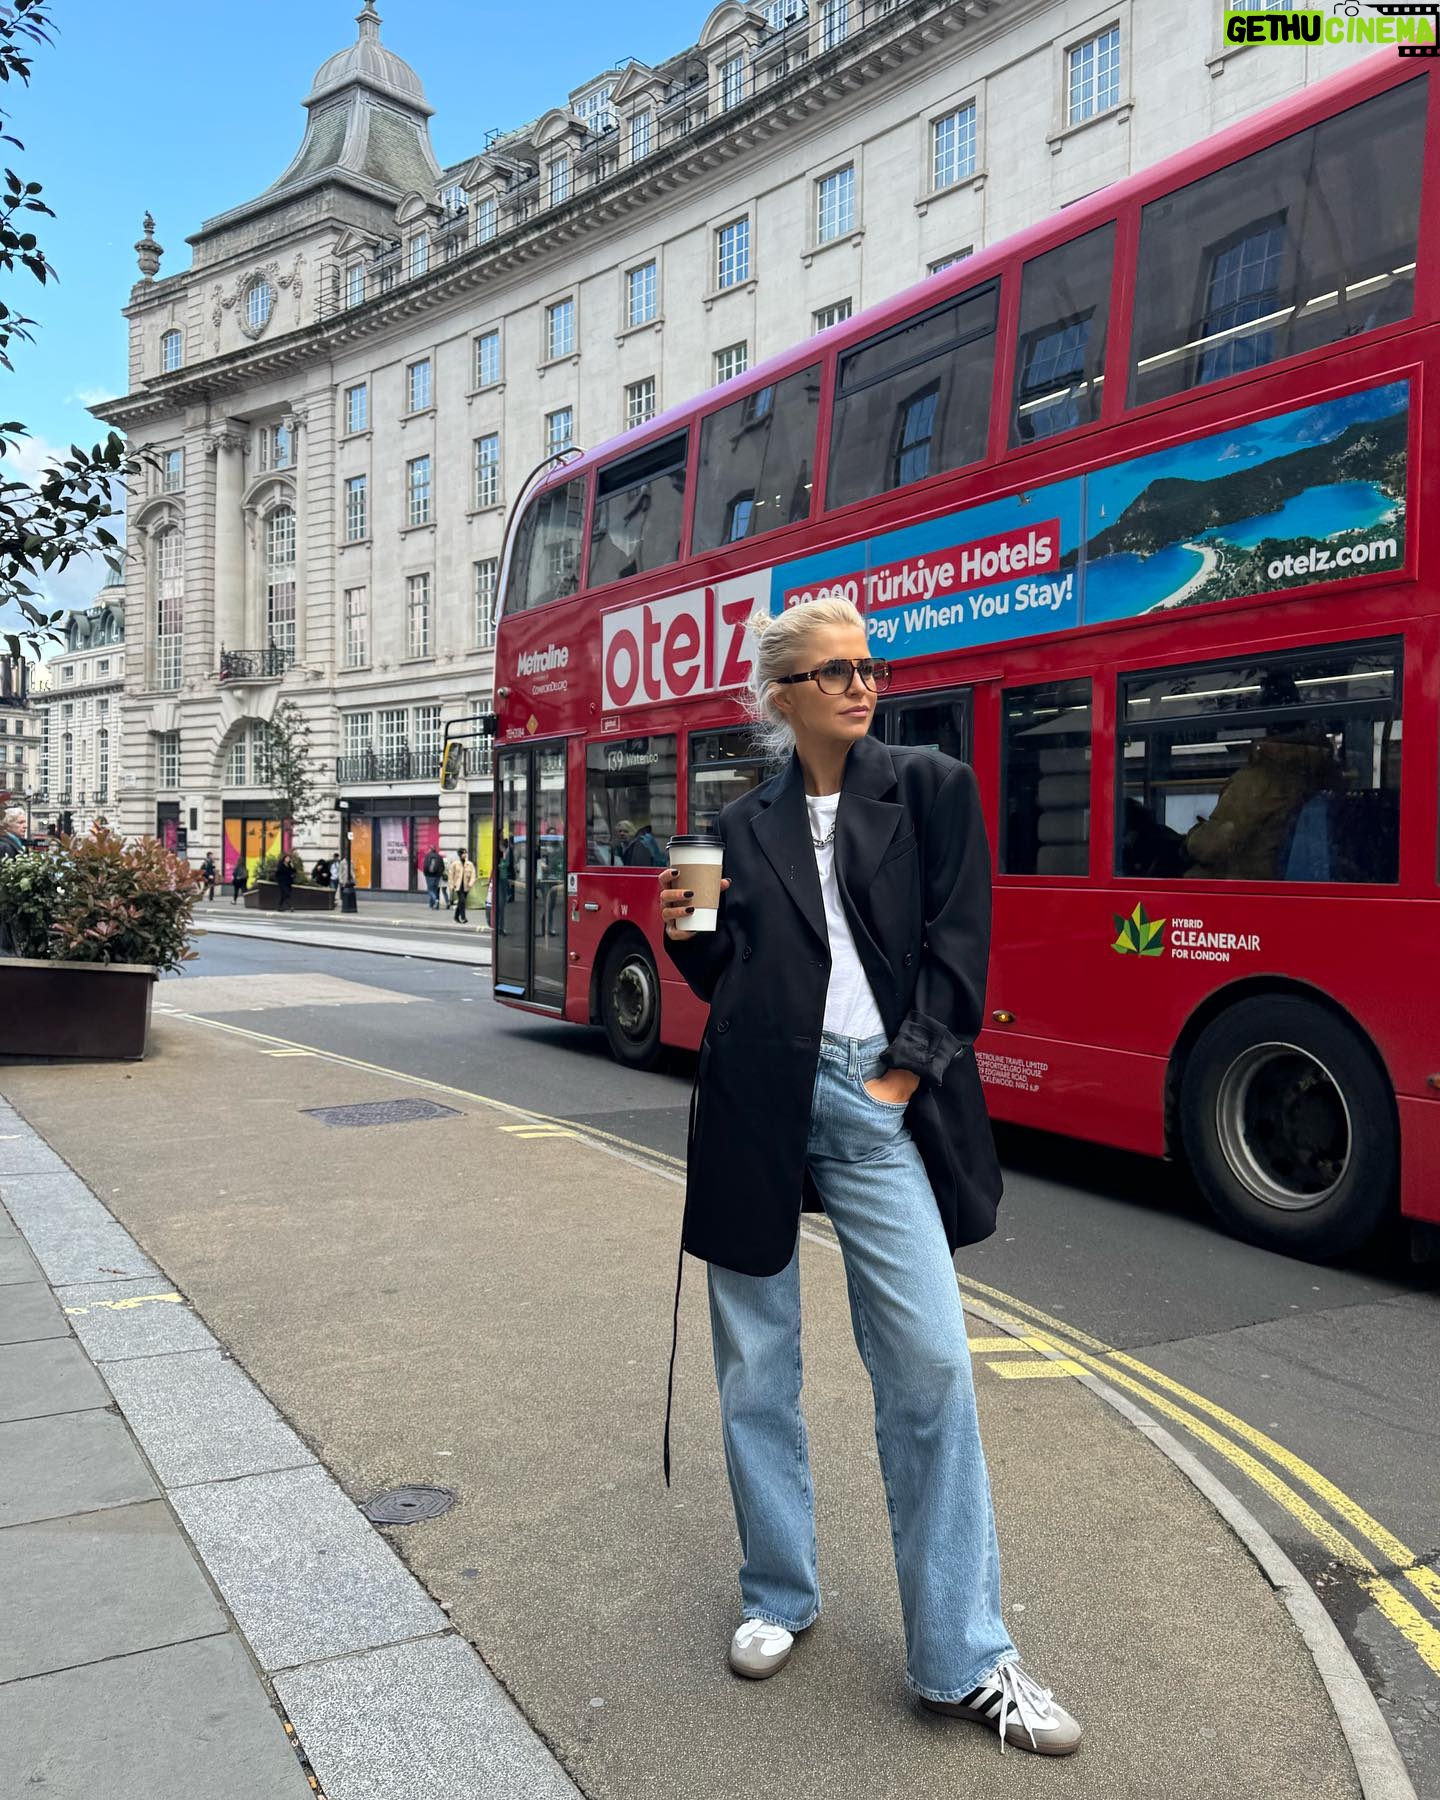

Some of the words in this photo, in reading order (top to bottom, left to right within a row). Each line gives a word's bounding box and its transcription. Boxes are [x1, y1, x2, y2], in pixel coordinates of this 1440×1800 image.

[863, 559, 955, 605] Türkiye
[961, 531, 1052, 583] Hotels
[1267, 538, 1397, 579] otelz.com
[867, 617, 900, 643] Pay
[904, 601, 963, 633] When
[968, 593, 1009, 620] You
[1015, 573, 1073, 611] Stay!
[516, 644, 569, 677] Metroline
[606, 587, 755, 707] otelz
[608, 750, 623, 772] 139
[626, 753, 659, 766] Waterloo
[1172, 918, 1203, 928] HYBRID
[1172, 949, 1189, 959] FOR
[1190, 950, 1230, 962] LONDON
[1026, 1061, 1048, 1071] LIMITED
